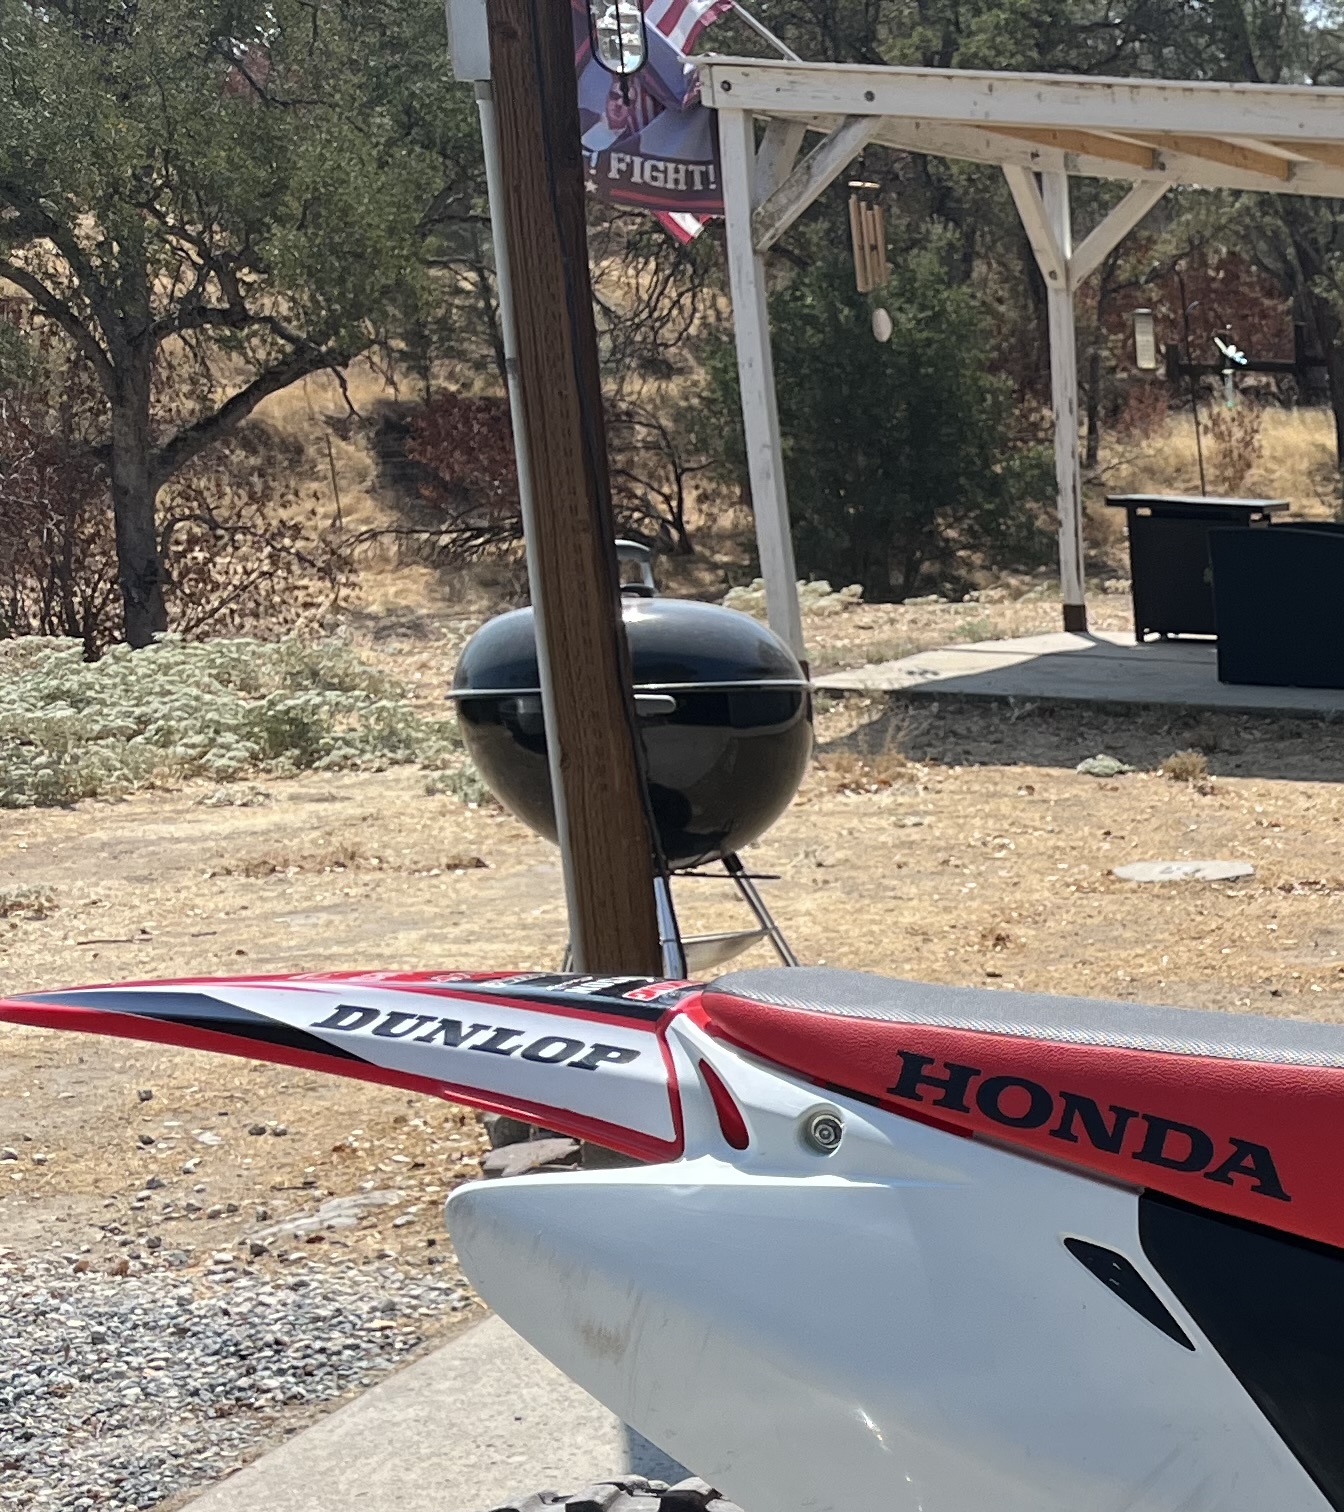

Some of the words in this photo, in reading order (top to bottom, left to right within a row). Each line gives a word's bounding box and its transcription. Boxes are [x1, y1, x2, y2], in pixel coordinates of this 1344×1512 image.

[607, 151, 717, 191] FIGHT!
[309, 1003, 642, 1071] DUNLOP
[886, 1048, 1292, 1202] HONDA
